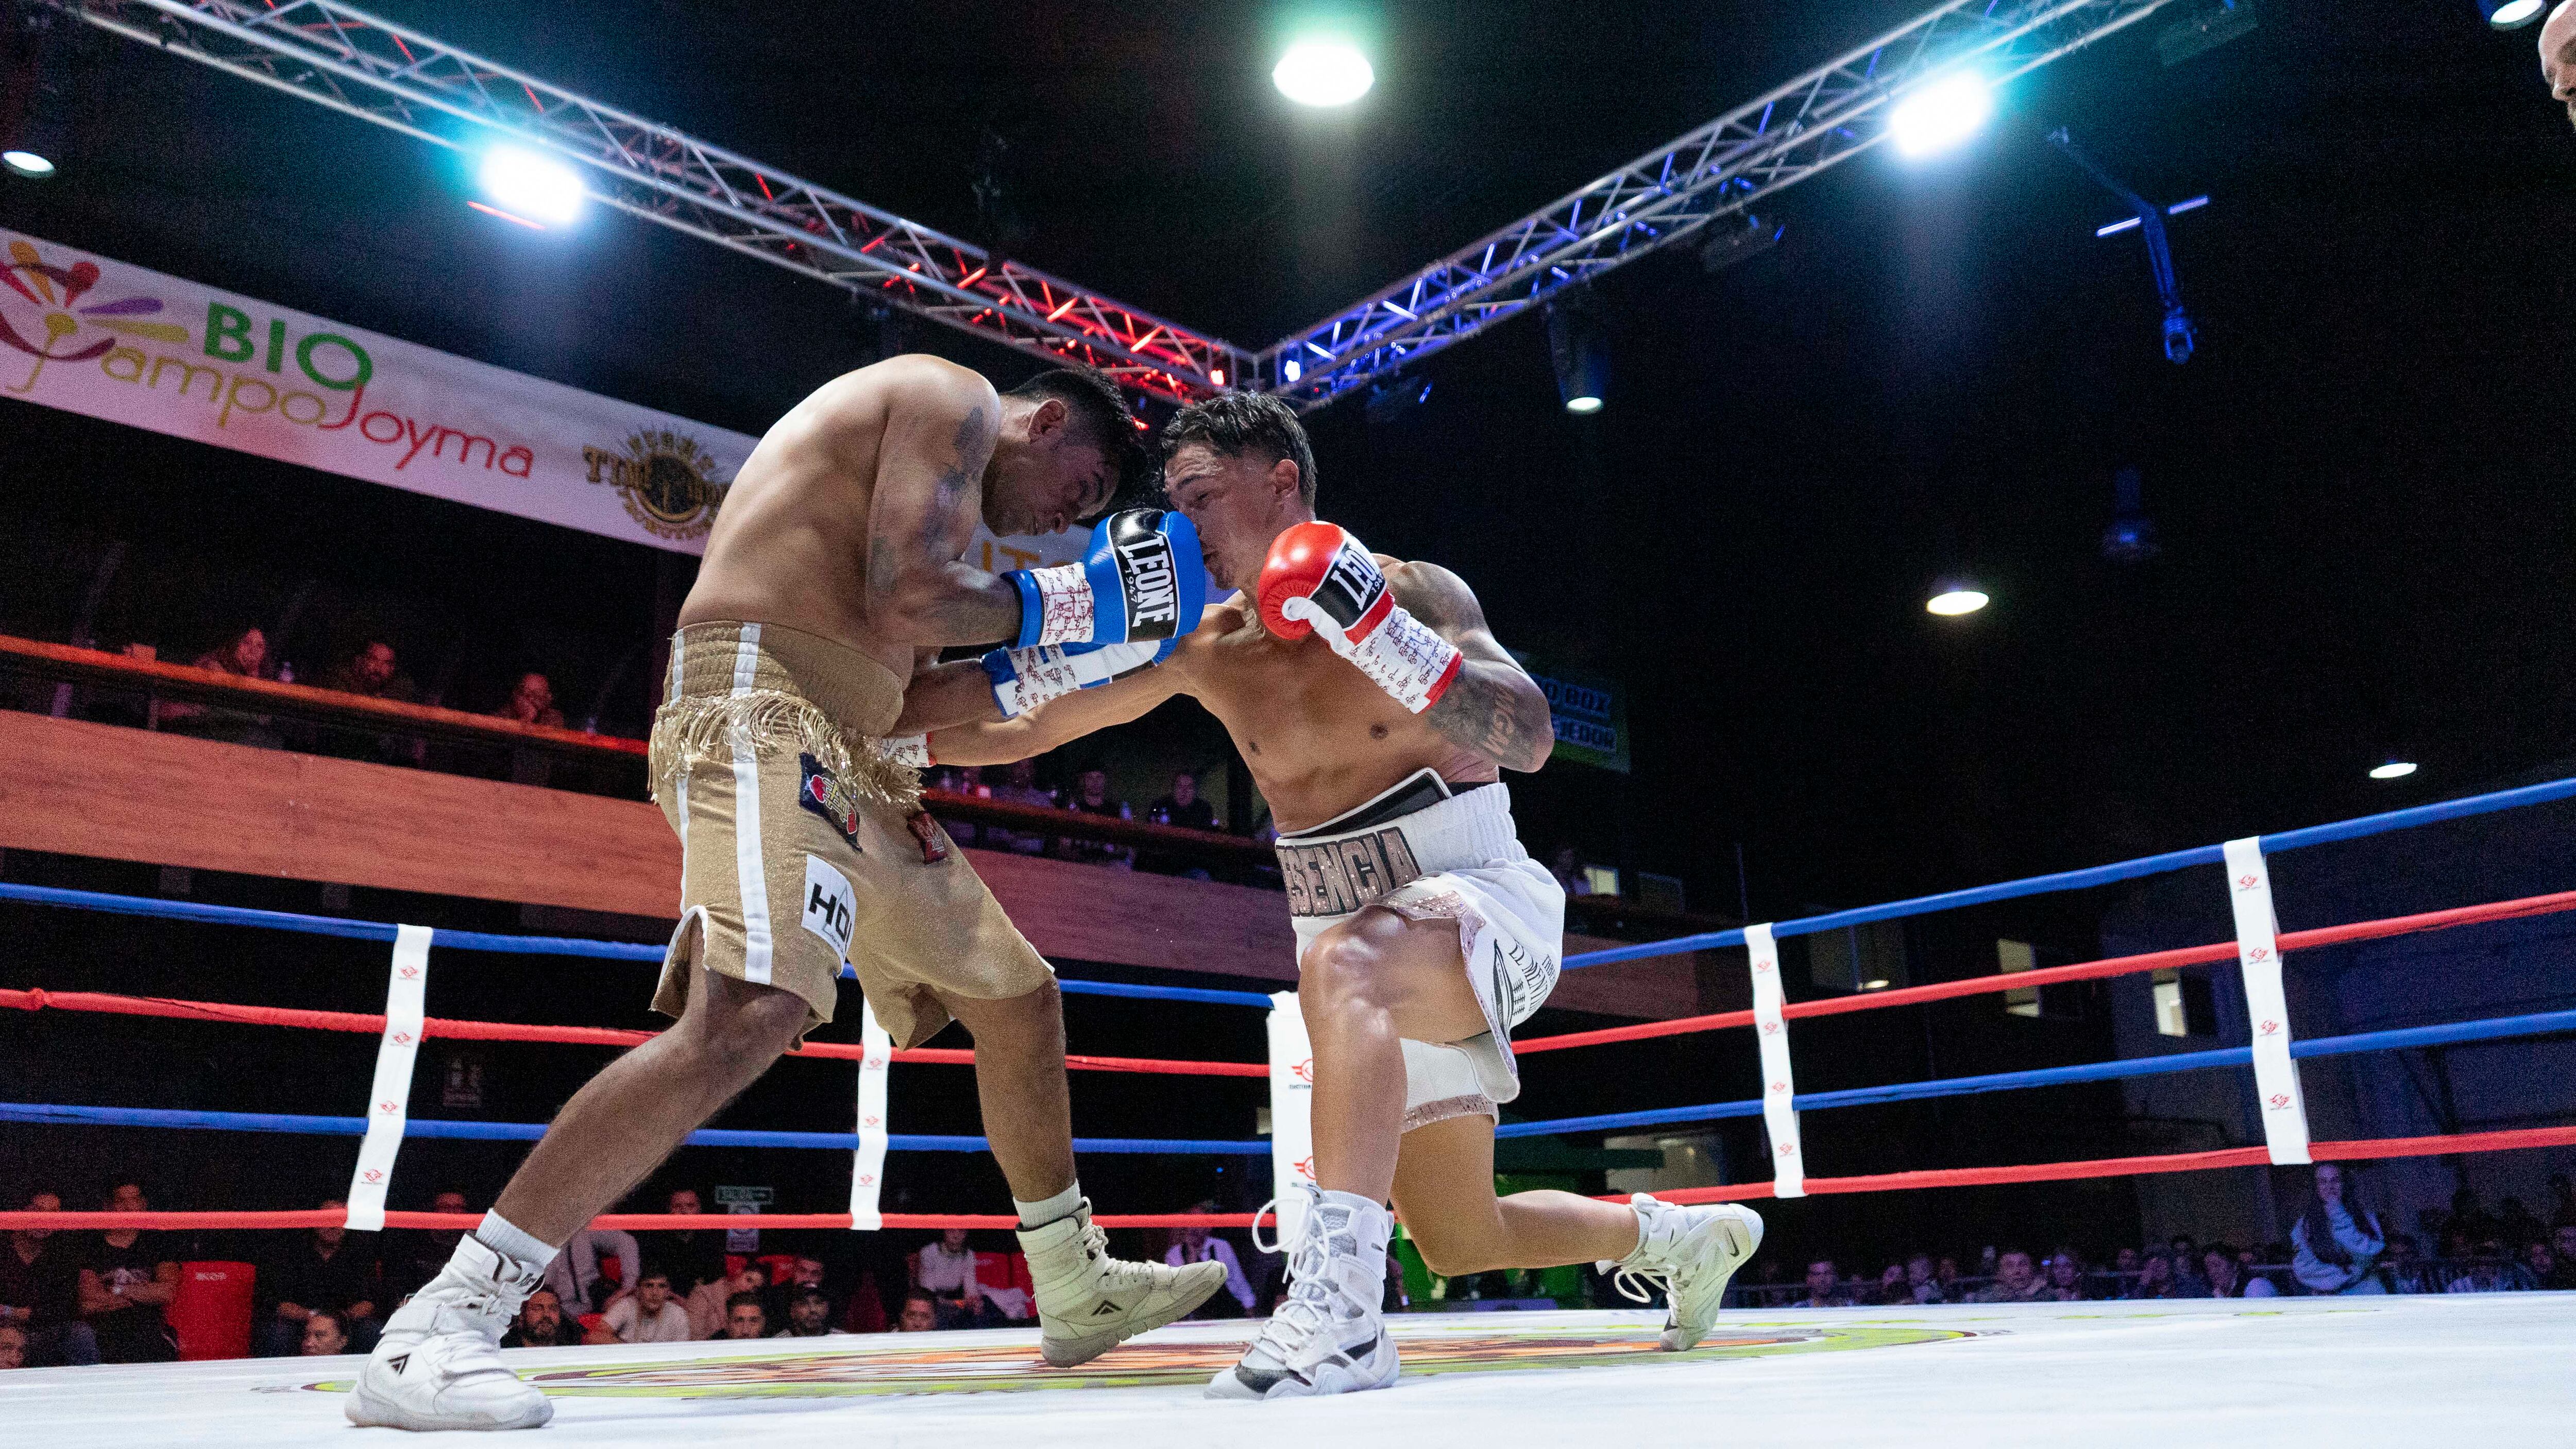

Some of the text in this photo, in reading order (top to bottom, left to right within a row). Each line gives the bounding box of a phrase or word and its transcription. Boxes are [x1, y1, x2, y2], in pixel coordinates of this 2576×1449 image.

[204, 301, 372, 391] BIO
[1118, 535, 1175, 628] LEONE
[1124, 568, 1138, 603] 1947
